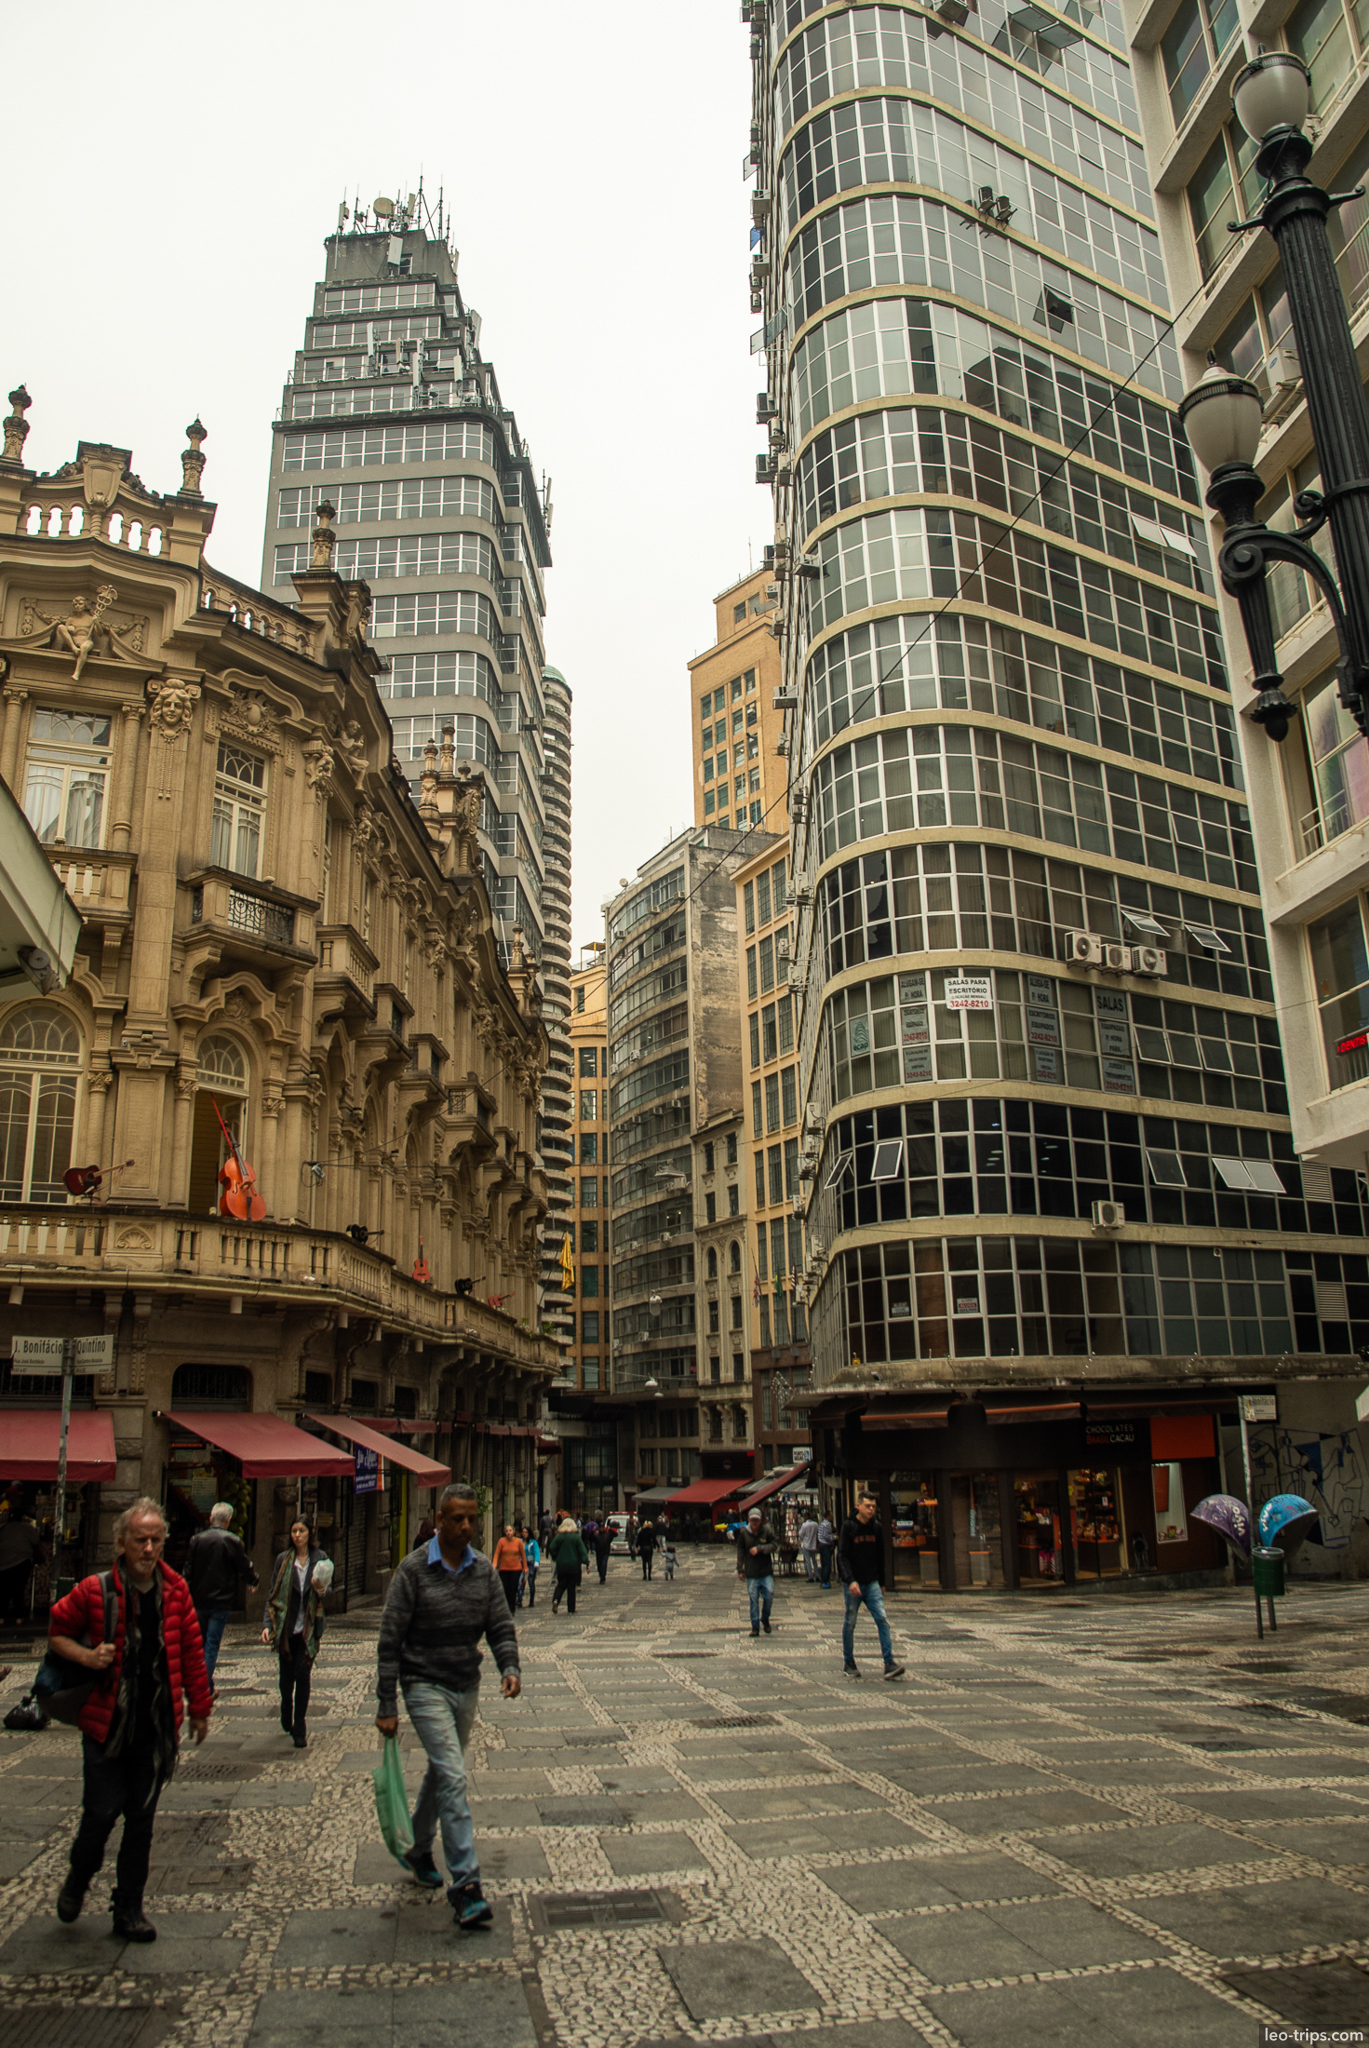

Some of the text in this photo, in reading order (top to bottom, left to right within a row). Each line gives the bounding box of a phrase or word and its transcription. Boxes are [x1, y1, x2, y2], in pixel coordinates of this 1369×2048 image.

[1030, 978, 1050, 989] ALUGA-SE
[1037, 993, 1049, 1003] HORA
[950, 1000, 989, 1008] 3242-8210
[1096, 996, 1124, 1012] SALAS
[1031, 1021, 1055, 1031] EQUIPADOS
[1031, 1032, 1058, 1043] 3242-8210
[1341, 1034, 1366, 1052] DENTIS
[14, 1339, 62, 1354] J. Bonifácio
[77, 1338, 105, 1354] Quintino
[1085, 1424, 1134, 1434] CHOCOLATES
[1110, 1434, 1135, 1443] CACAU
[1232, 1506, 1245, 1537] vivo
[1261, 1503, 1273, 1532] vivo
